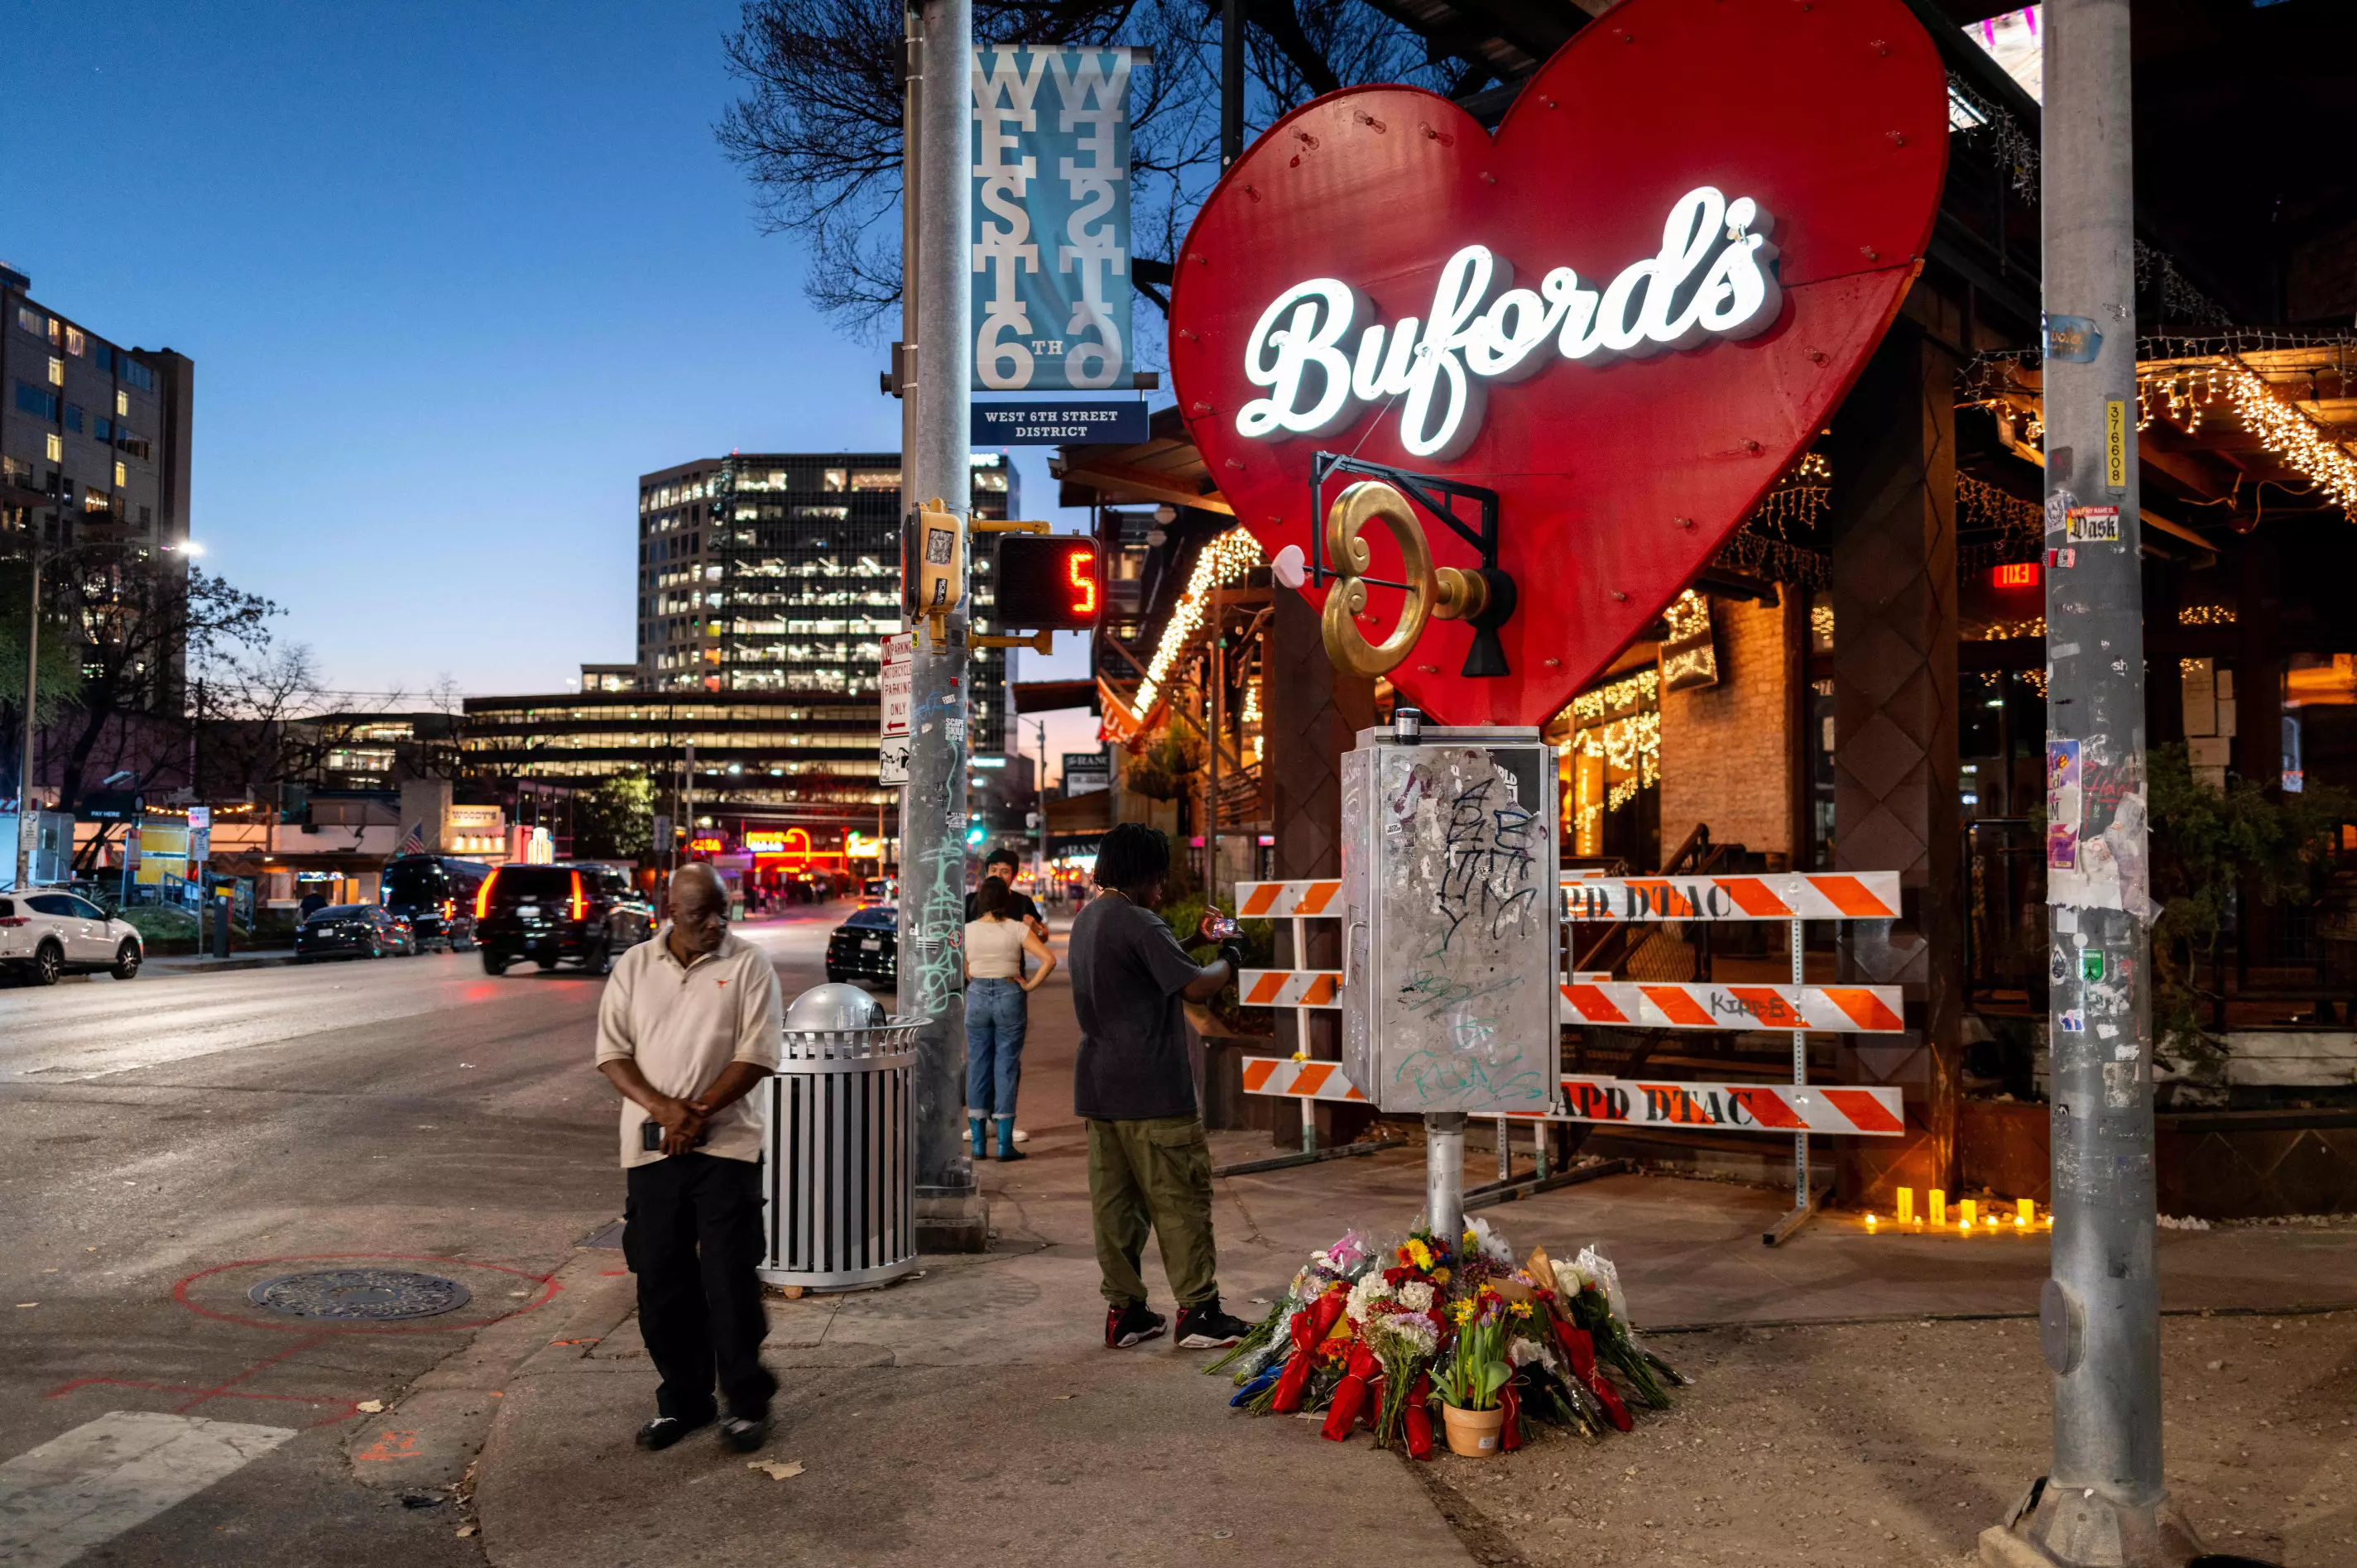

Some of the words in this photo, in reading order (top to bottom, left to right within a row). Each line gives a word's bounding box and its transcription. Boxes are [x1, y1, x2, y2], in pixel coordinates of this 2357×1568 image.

[972, 47, 1038, 314] WEST
[1236, 186, 1768, 457] Buford's
[985, 412, 1025, 422] WEST
[1030, 411, 1058, 422] 6TH
[1062, 410, 1119, 422] STREET
[1015, 426, 1088, 437] DISTRICT
[2110, 406, 2121, 482] 376608
[1070, 552, 1095, 611] 5
[881, 641, 891, 660] NO
[891, 640, 912, 656] PARKING
[885, 681, 911, 697] PARKING
[890, 702, 906, 716] ONLY
[1625, 885, 1731, 917] DTAC
[1552, 1085, 1630, 1120] APD
[1644, 1088, 1754, 1125] DTAC
